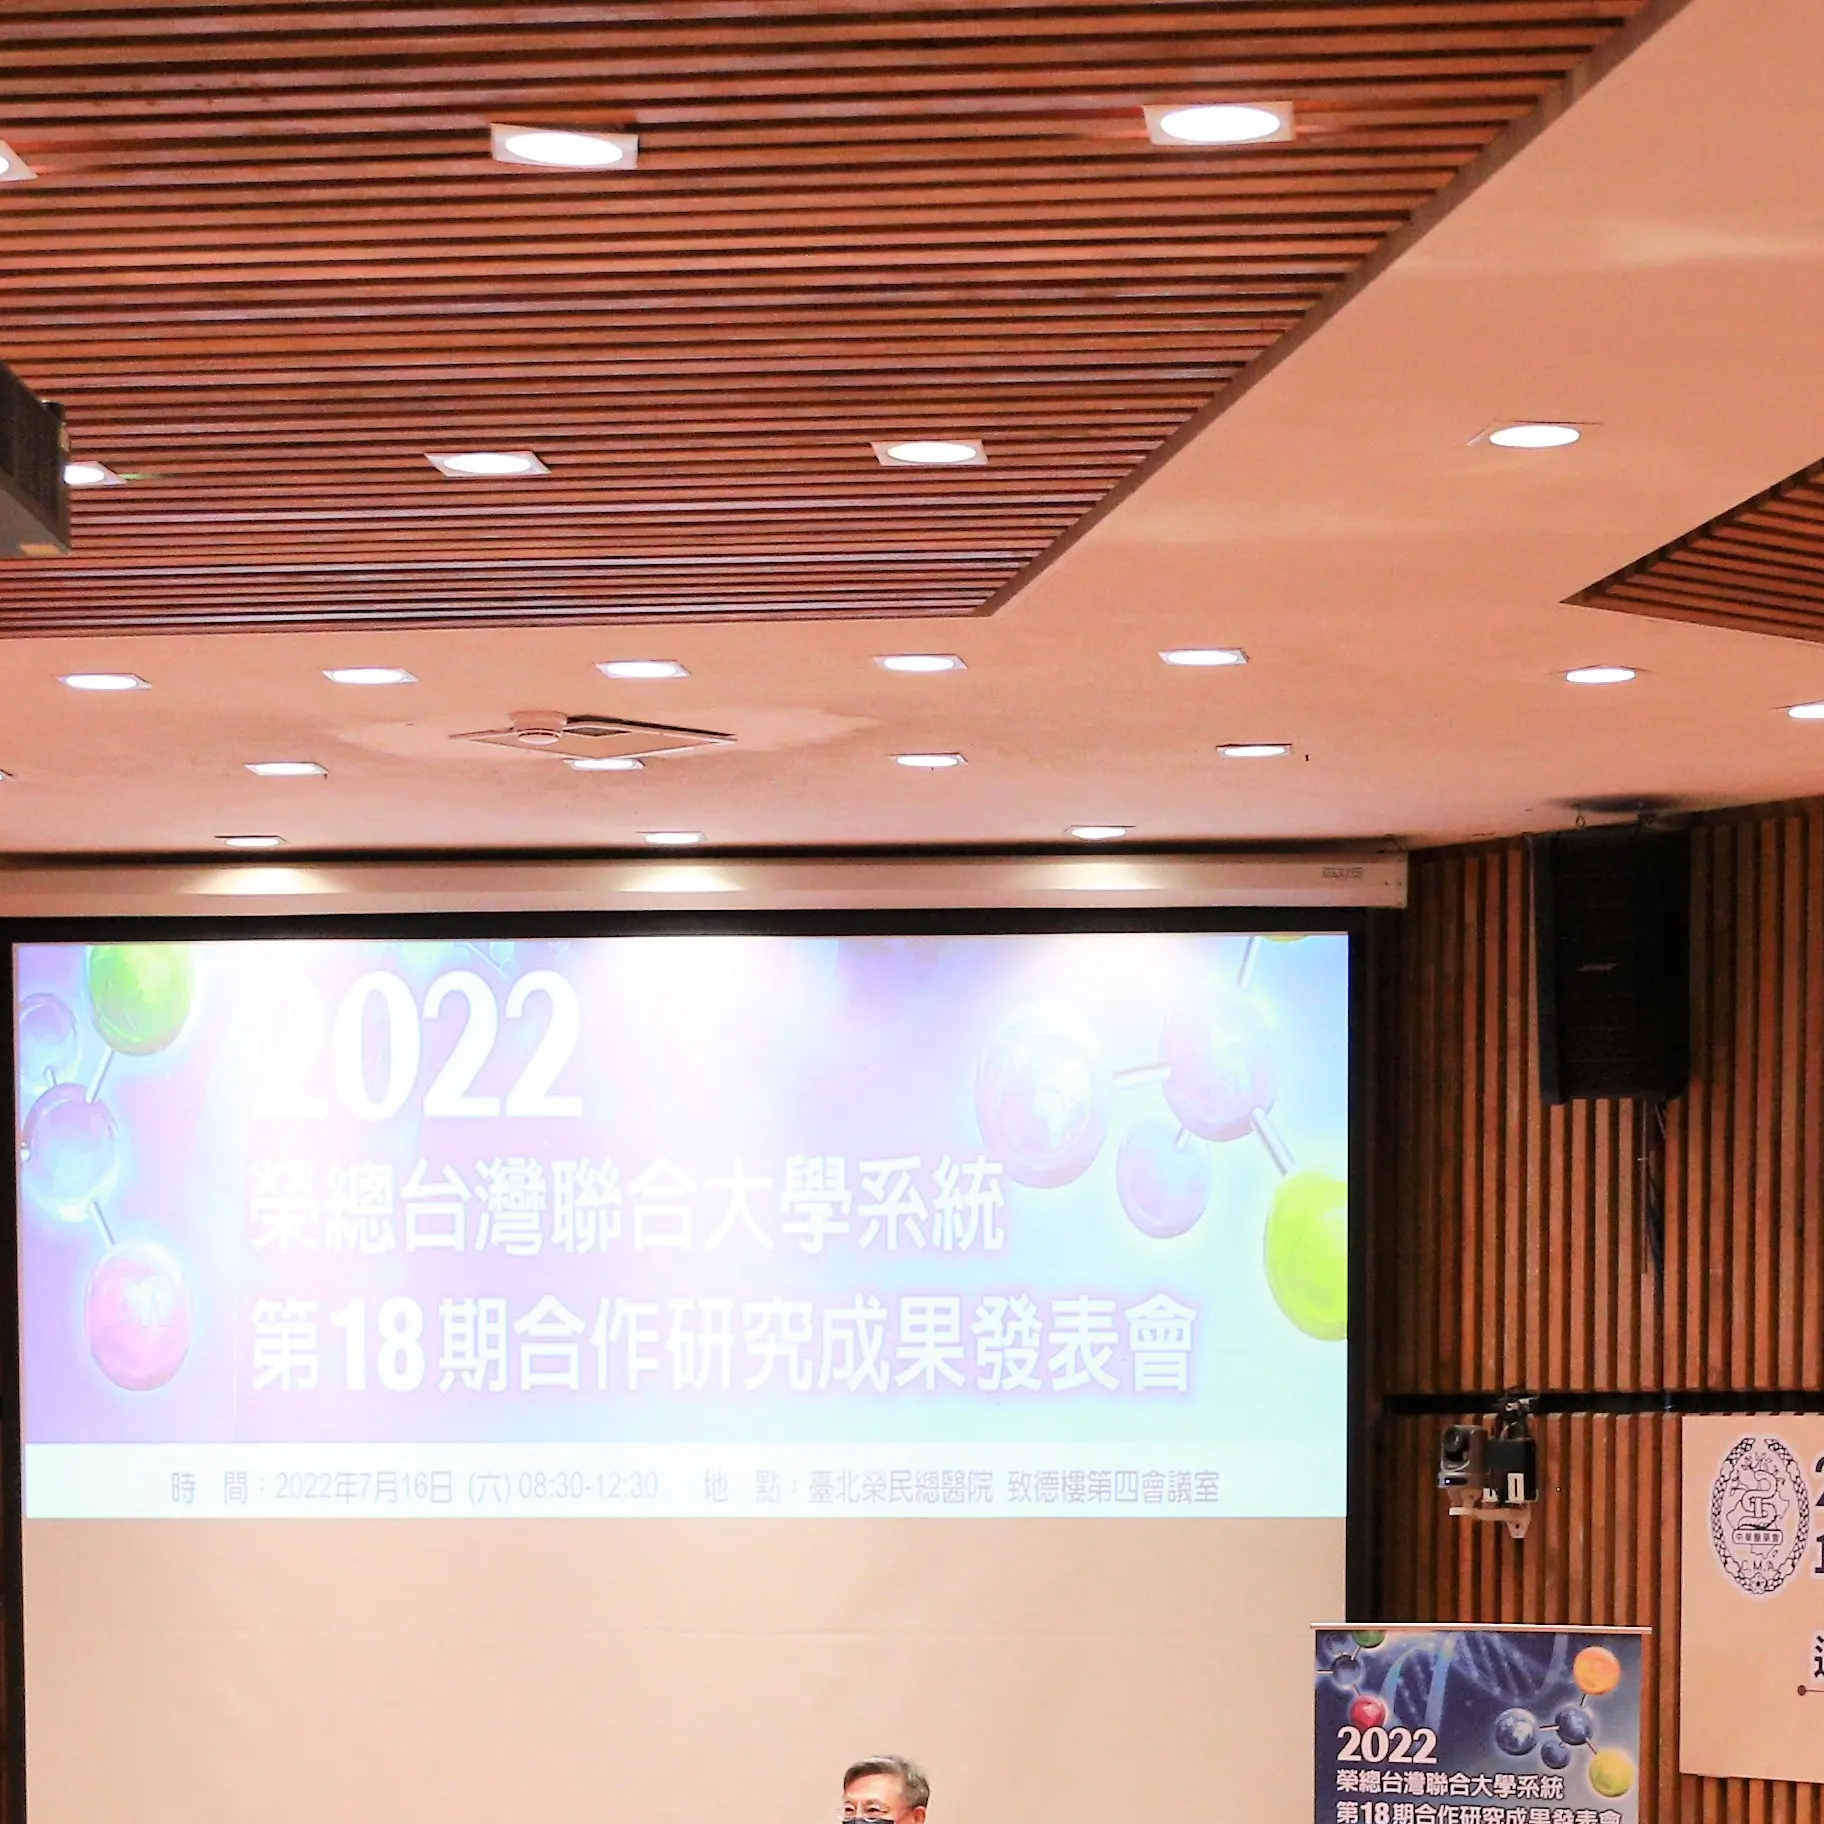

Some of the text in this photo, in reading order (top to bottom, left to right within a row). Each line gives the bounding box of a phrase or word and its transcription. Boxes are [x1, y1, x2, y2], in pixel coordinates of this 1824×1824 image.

[251, 968, 584, 1122] 2022
[249, 1154, 1005, 1258] 榮總台灣聯合大學系統
[247, 1294, 1197, 1393] 第18期合作研究成果發表會
[1336, 1768, 1564, 1800] 榮總台灣聯合大學系統
[1337, 1725, 1438, 1764] 2022
